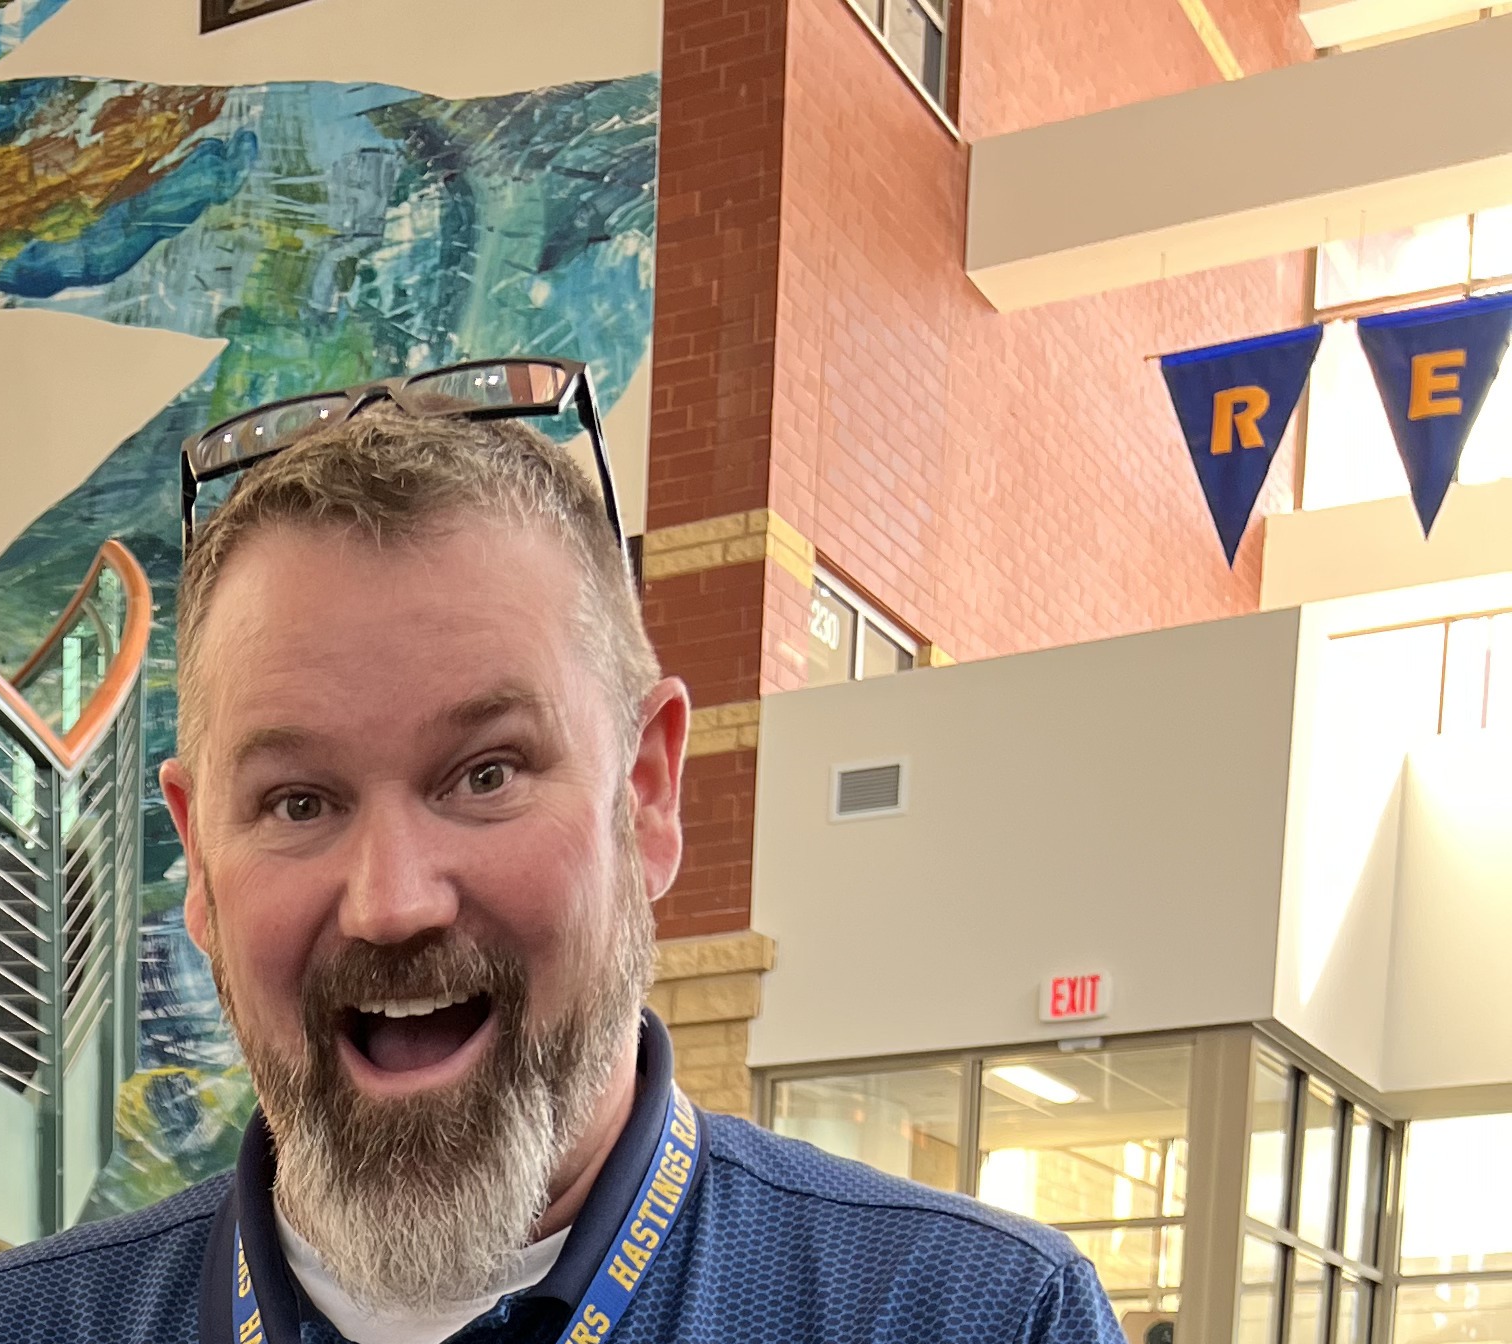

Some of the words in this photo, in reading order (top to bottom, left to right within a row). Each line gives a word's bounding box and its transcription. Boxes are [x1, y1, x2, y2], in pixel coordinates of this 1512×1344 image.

[1210, 385, 1270, 455] R
[1407, 348, 1467, 421] E
[810, 600, 840, 650] 230
[1050, 974, 1101, 1018] EXIT
[607, 1142, 692, 1293] HASTINGS
